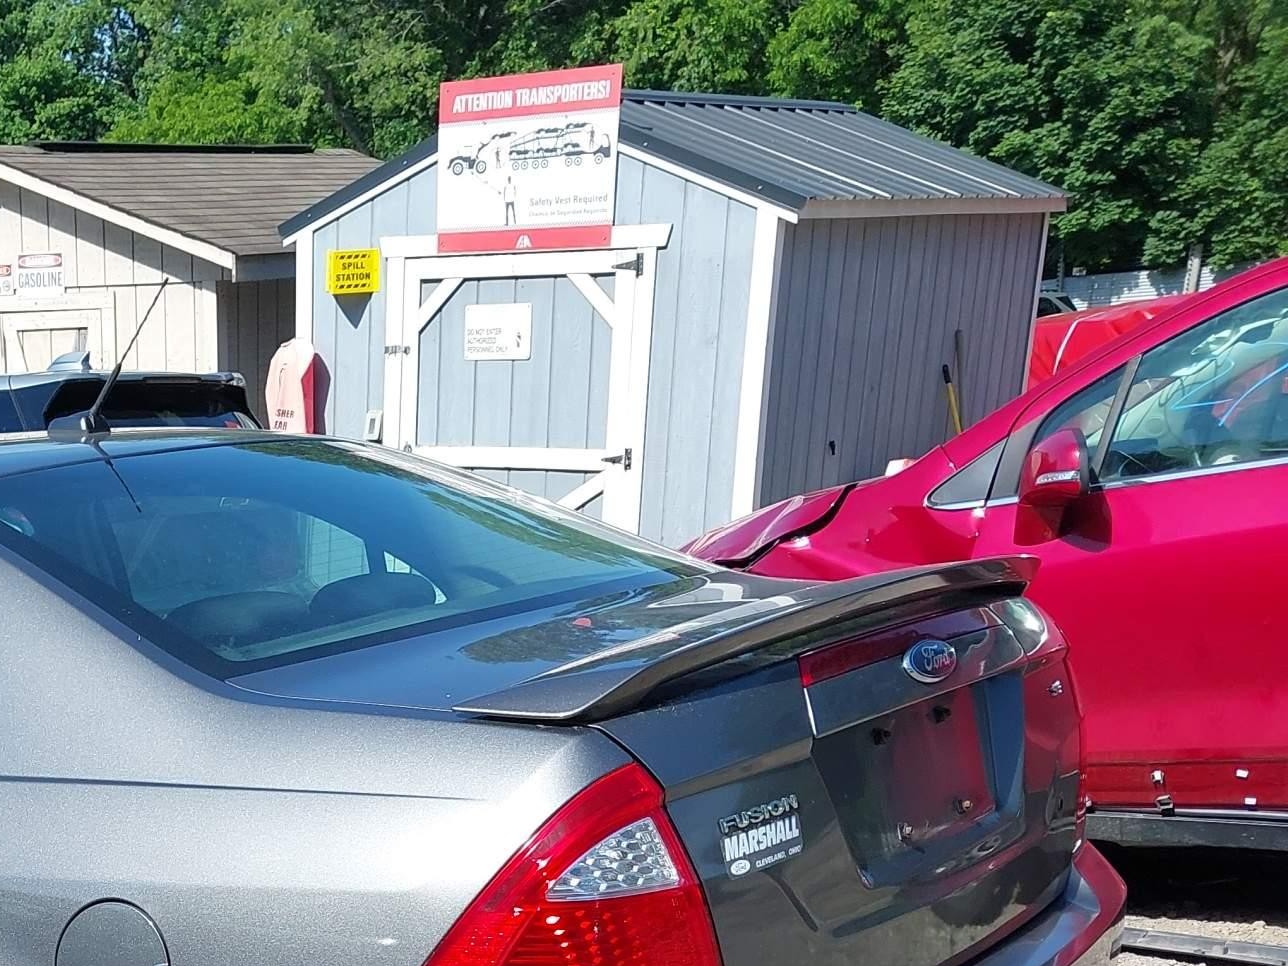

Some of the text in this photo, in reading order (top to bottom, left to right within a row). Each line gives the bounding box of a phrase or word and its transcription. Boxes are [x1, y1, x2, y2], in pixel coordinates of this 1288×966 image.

[452, 80, 611, 113] ATTENTION TRANSPORTERS!
[529, 192, 608, 207] Safety Vest Required
[336, 272, 371, 282] STATION
[342, 262, 366, 271] SPILL
[18, 272, 63, 289] GASOLINE
[921, 644, 952, 672] Ford
[719, 794, 799, 834] FUSION
[724, 815, 799, 862] MARSHALL
